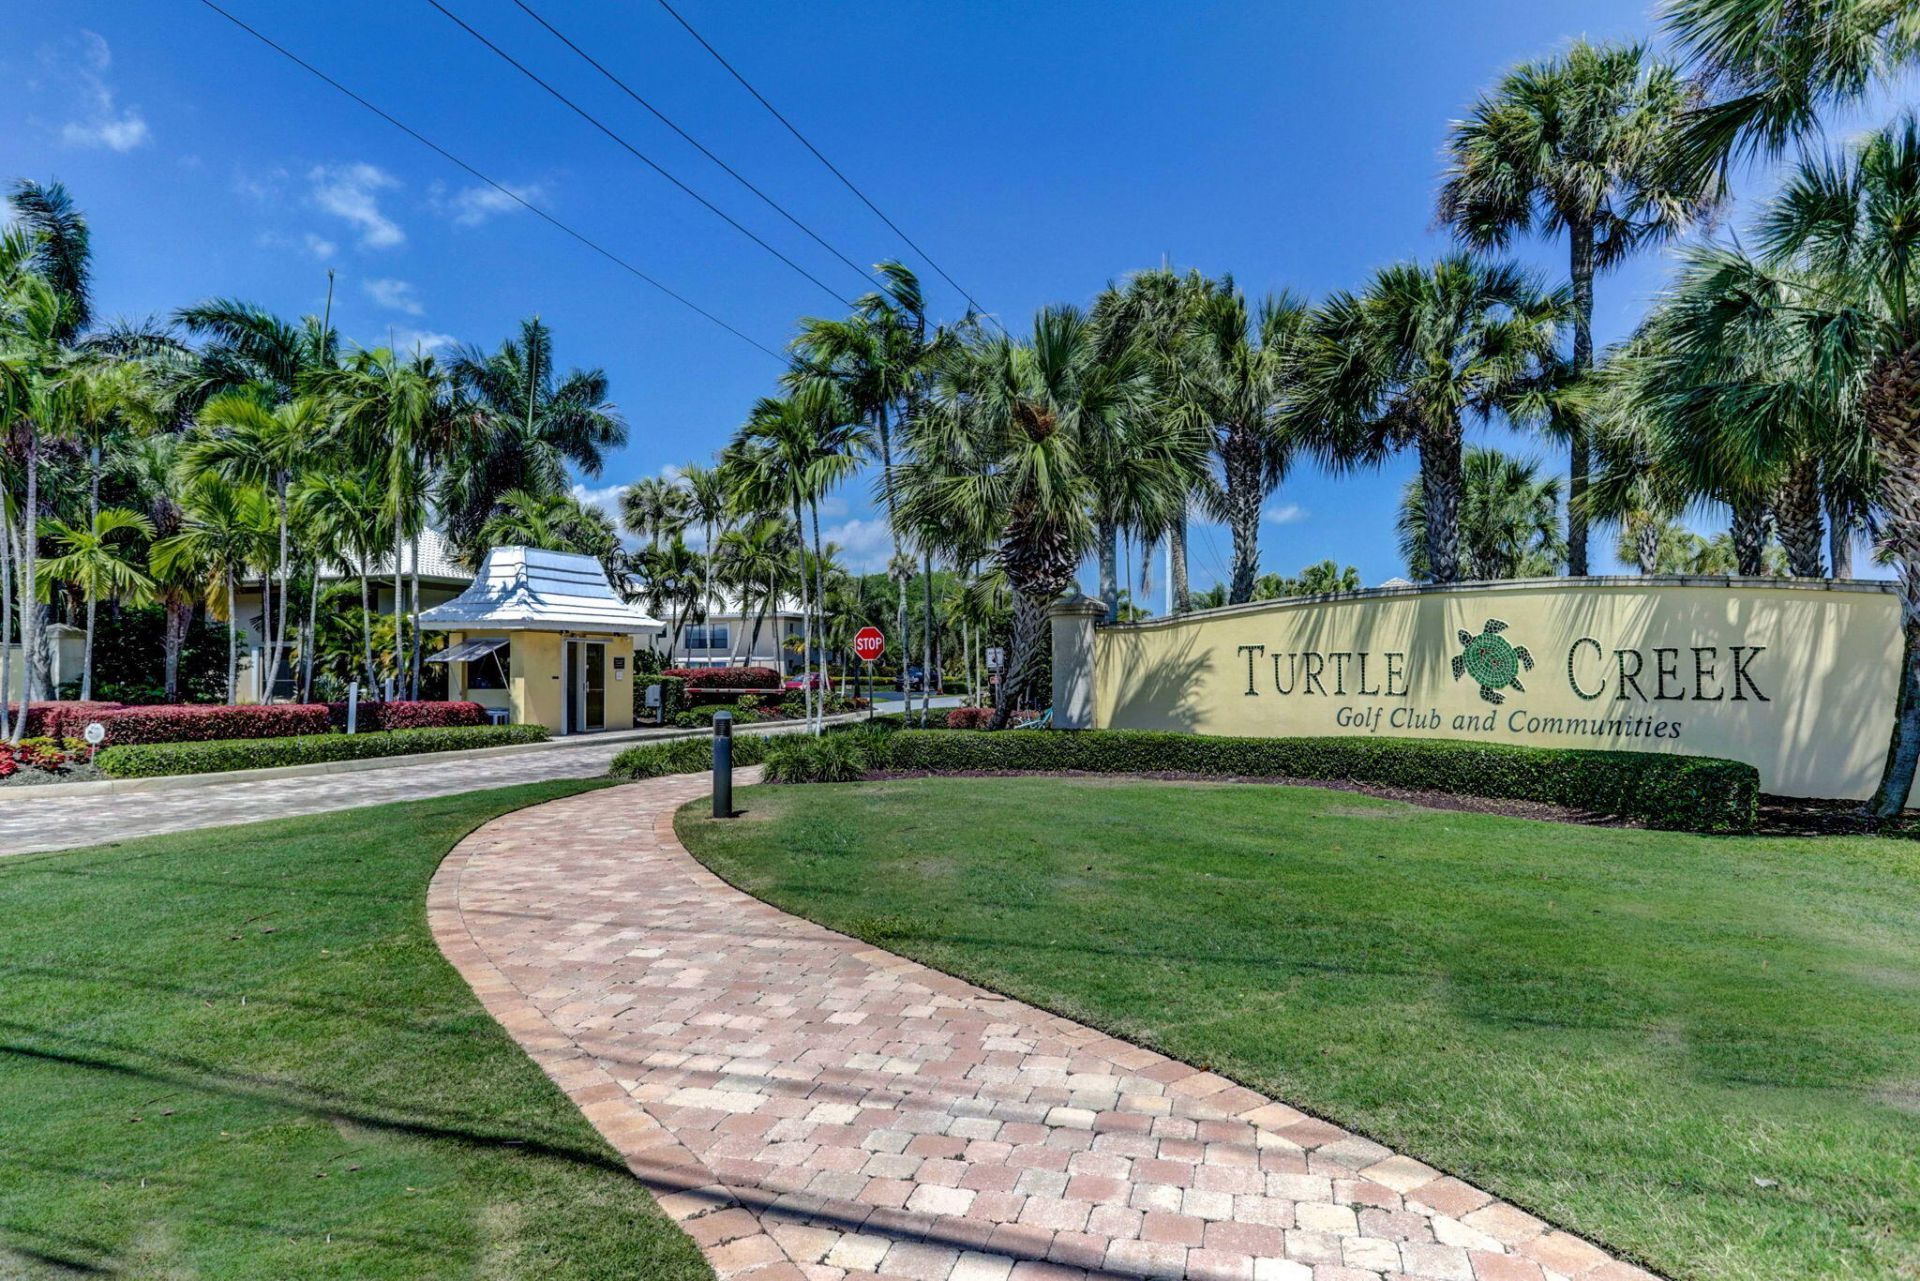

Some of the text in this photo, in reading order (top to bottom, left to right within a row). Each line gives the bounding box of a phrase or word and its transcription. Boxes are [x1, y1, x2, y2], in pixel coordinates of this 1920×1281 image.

[857, 637, 882, 650] STOP
[1237, 637, 1771, 702] TURTLE CREEK
[1336, 706, 1682, 739] Golf Club and Communities
